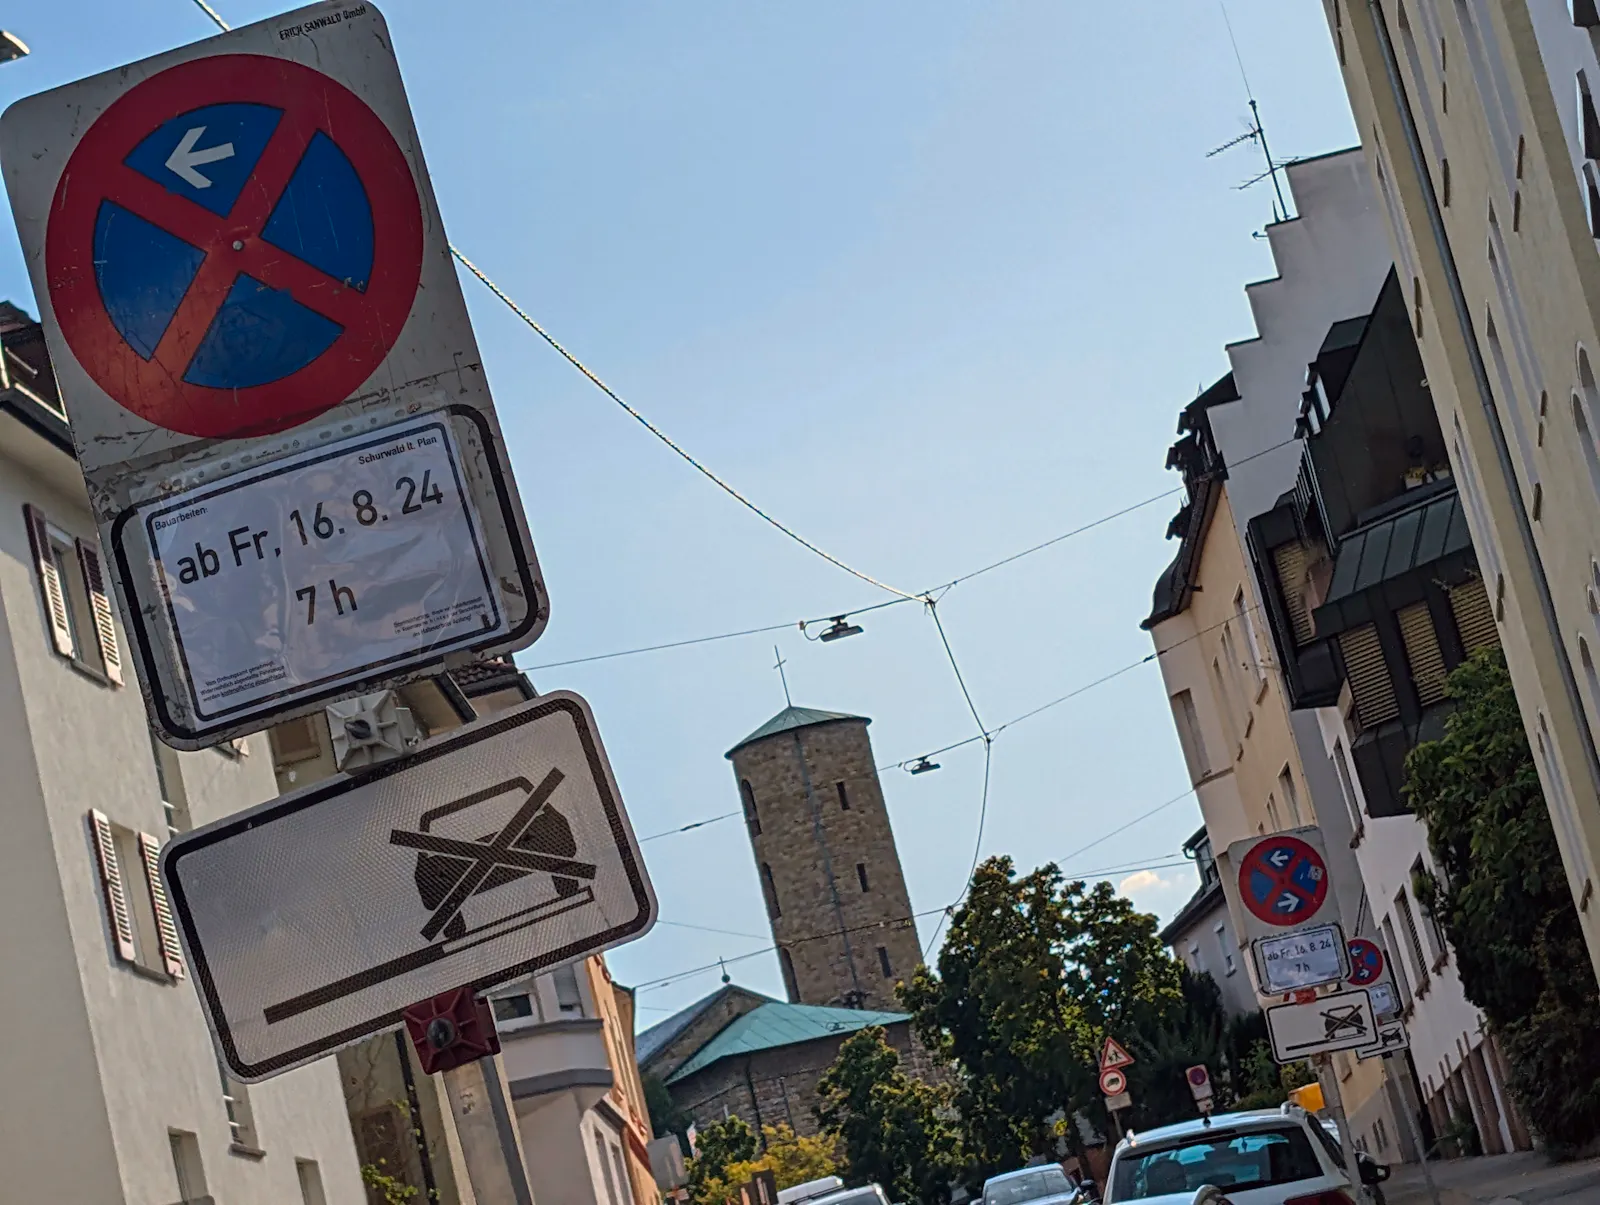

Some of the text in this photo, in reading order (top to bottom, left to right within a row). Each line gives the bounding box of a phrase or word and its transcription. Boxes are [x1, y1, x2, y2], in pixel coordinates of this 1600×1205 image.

[304, 13, 342, 33] SANWALD
[343, 5, 366, 20] GmbH
[358, 443, 405, 465] Schurwald
[417, 436, 438, 448] Plan
[154, 507, 209, 531] Bauarbeiten:
[177, 469, 444, 585] ab Fr, 16. 8. 24
[295, 585, 316, 626] 7
[328, 579, 359, 616] h
[1267, 950, 1279, 961] ab
[1295, 962, 1311, 973] 7 h
